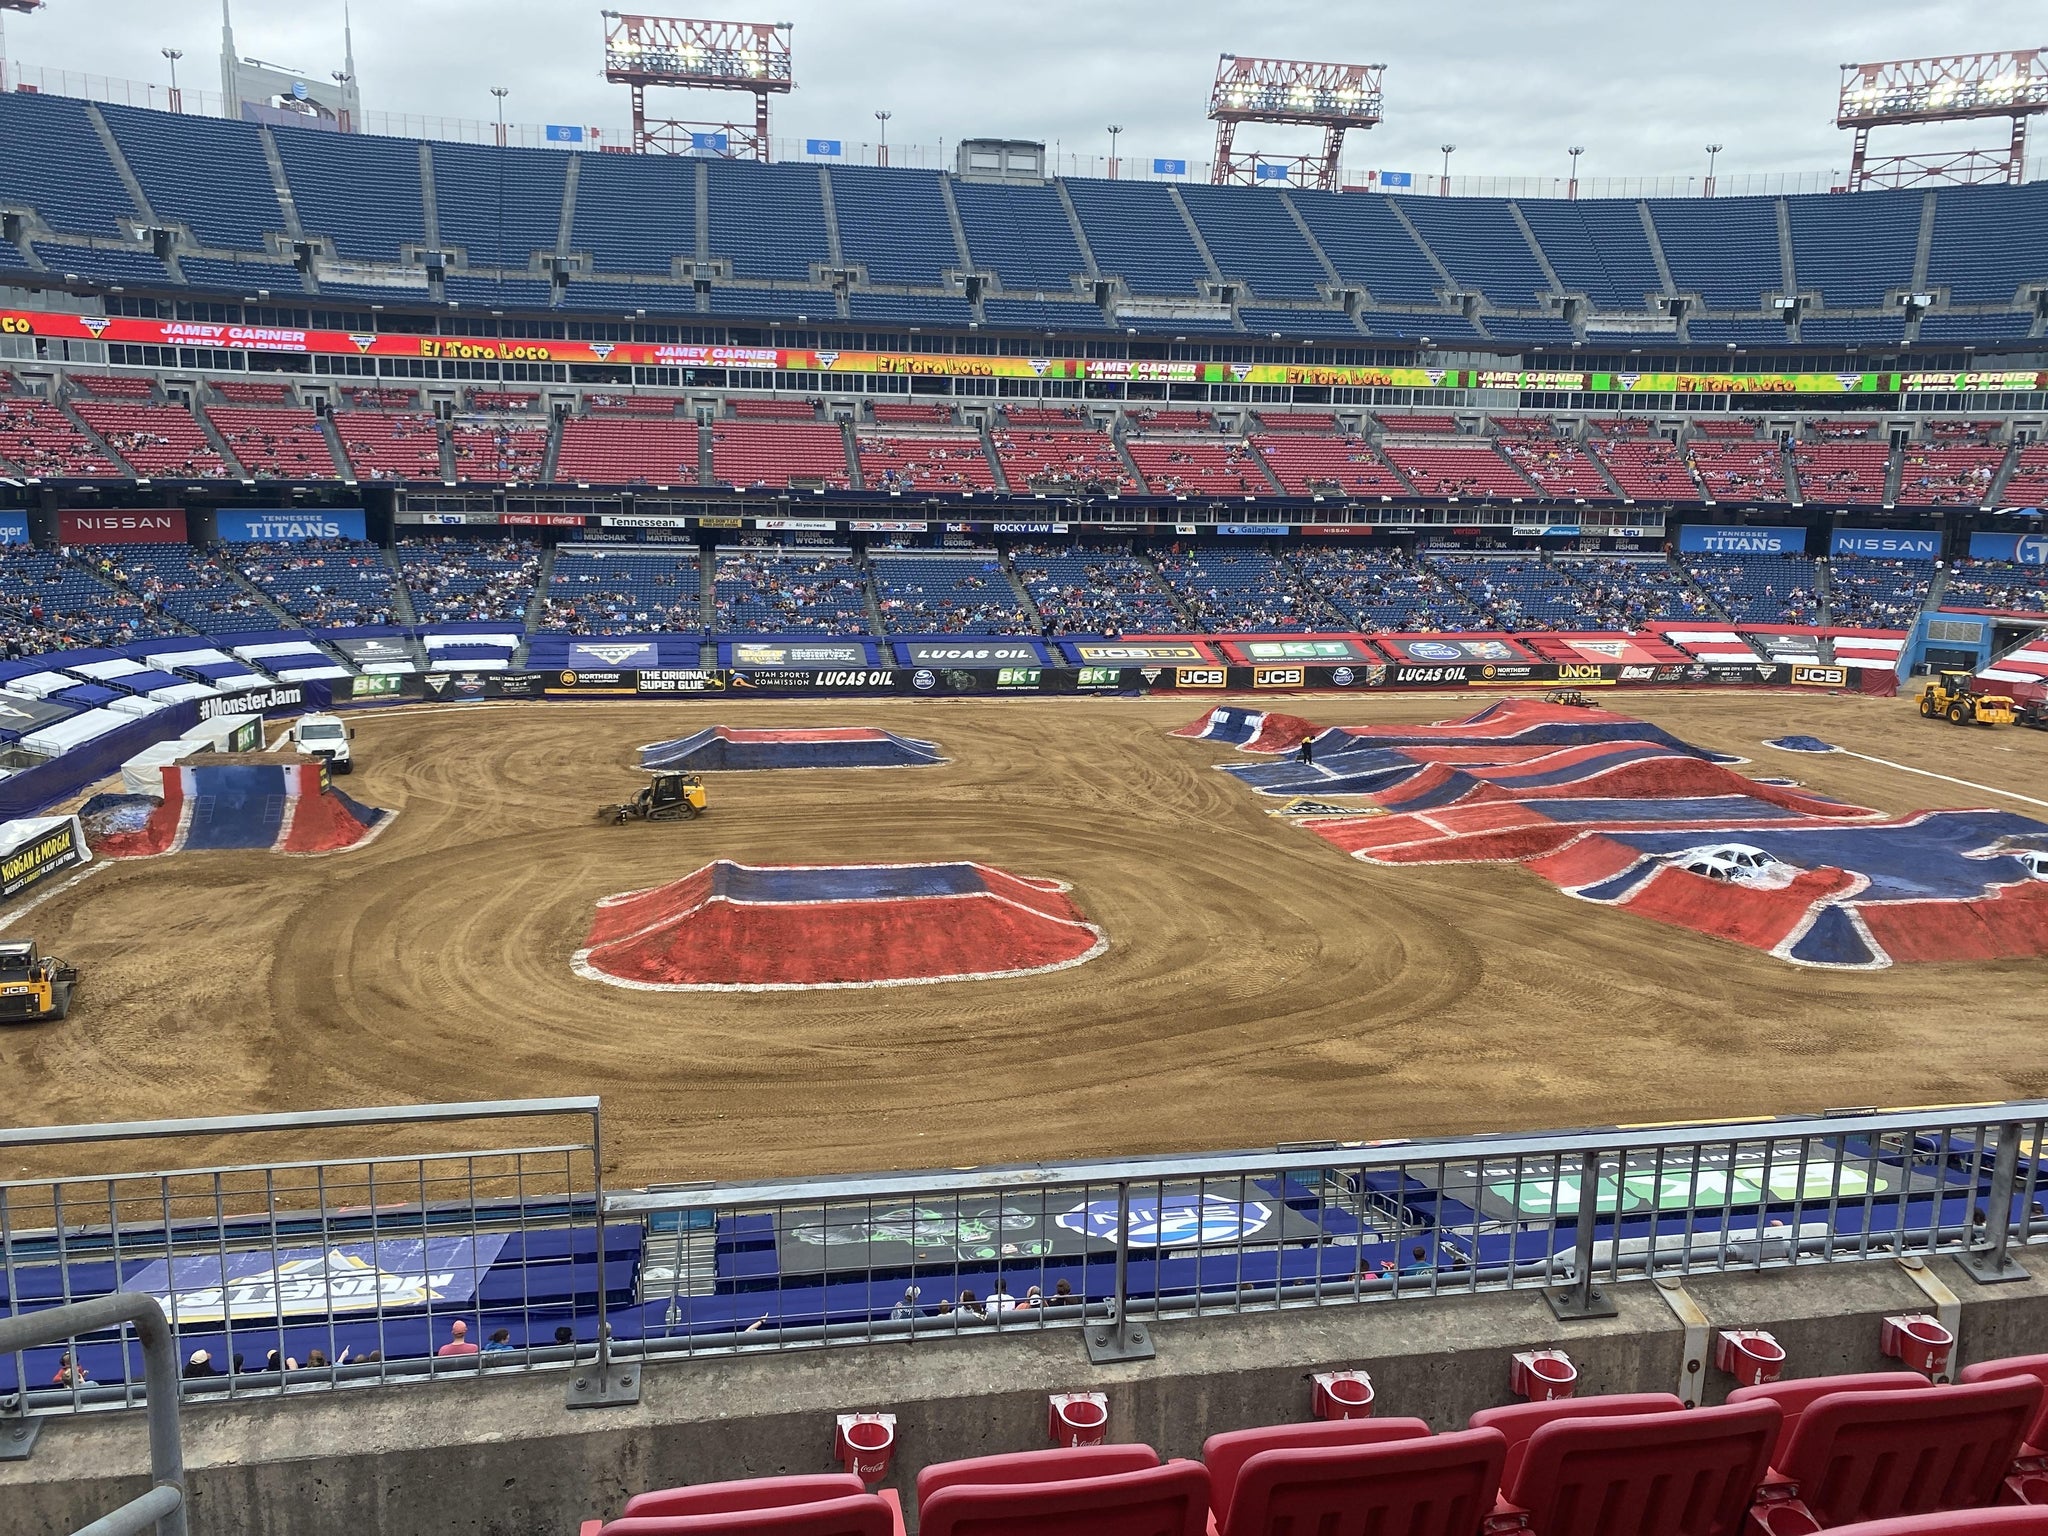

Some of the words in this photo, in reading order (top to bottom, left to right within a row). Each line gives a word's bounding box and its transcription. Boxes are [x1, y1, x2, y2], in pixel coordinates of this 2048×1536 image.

[160, 324, 224, 338] JAMEY
[228, 328, 306, 342] GARNER
[655, 346, 709, 358] JAMEY
[711, 348, 777, 360] GARNER
[1086, 362, 1133, 372] JAMEY
[1138, 363, 1197, 374] GARNER
[1478, 371, 1523, 381] JAMEY
[1525, 372, 1584, 383] GARNER
[1902, 373, 1960, 384] JAMEY
[1964, 373, 2039, 384] GARNER
[76, 516, 172, 529] NISSAN
[439, 515, 462, 524] tsu
[610, 516, 679, 528] Tennessean.
[246, 523, 340, 538] TITANS
[946, 523, 972, 532] FedEx
[993, 523, 1027, 532] ROCKY
[1028, 524, 1050, 533] LAW
[1241, 526, 1279, 535] Gallagher
[1513, 527, 1541, 536] Pinnacle
[1621, 528, 1640, 536] tsu
[1703, 537, 1781, 551] TITANS
[1839, 538, 1933, 551] NISSAN
[918, 650, 989, 659] LUCAS
[640, 671, 660, 681] THE
[662, 671, 709, 681] ORIGINAL
[998, 670, 1041, 683] BKT
[1079, 670, 1120, 683] BKT
[1180, 670, 1223, 684] JCB
[1258, 670, 1300, 684] JCB
[1397, 667, 1443, 681] LUCAS
[1558, 664, 1602, 678] UNOH
[1658, 673, 1681, 681] CARS
[1796, 668, 1842, 683] JCB
[353, 676, 400, 692] BKT
[640, 681, 677, 691] SUPER
[678, 680, 704, 690] GLUE
[815, 672, 866, 686] LUCAS
[200, 688, 301, 719] #MonsterJam
[238, 725, 255, 751] BKT
[1, 850, 34, 882] MORGAN
[35, 847, 41, 864] &
[41, 832, 70, 861] MORGAN
[2, 986, 28, 994] JCB
[1092, 1205, 1237, 1225] SPIN
[861, 1460, 886, 1472] Coca-Cola
